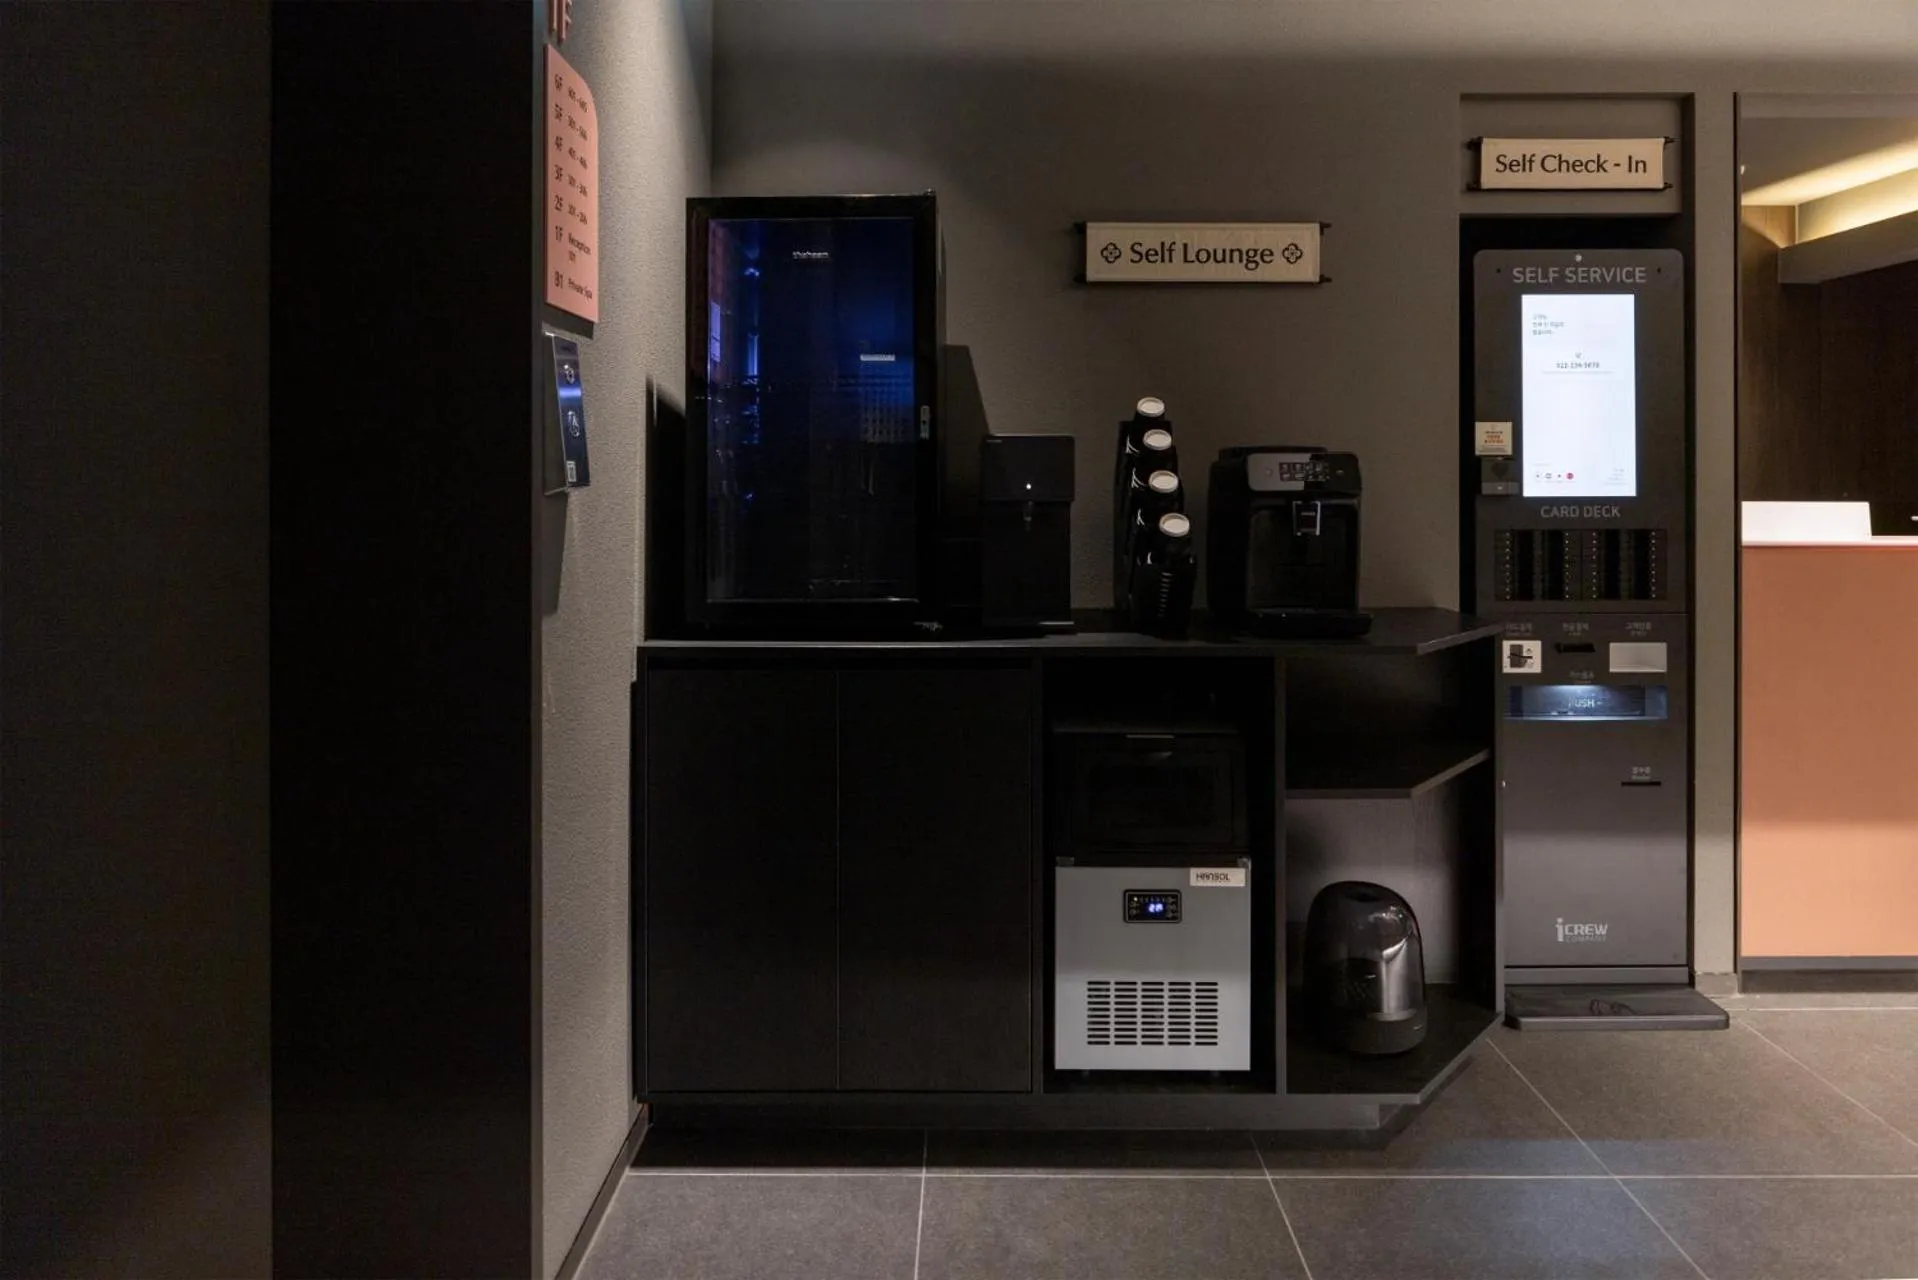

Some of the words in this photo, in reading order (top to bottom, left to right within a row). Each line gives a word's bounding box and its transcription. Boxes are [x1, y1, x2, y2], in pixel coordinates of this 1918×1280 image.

[1495, 153, 1536, 173] Self
[1540, 153, 1608, 173] Check
[1628, 155, 1647, 173] In
[1129, 241, 1176, 264] Self
[1182, 243, 1274, 271] Lounge
[1512, 266, 1560, 283] SELF
[1565, 266, 1647, 283] SERVICE
[1540, 505, 1580, 518] CARD
[1583, 505, 1621, 518] DECK
